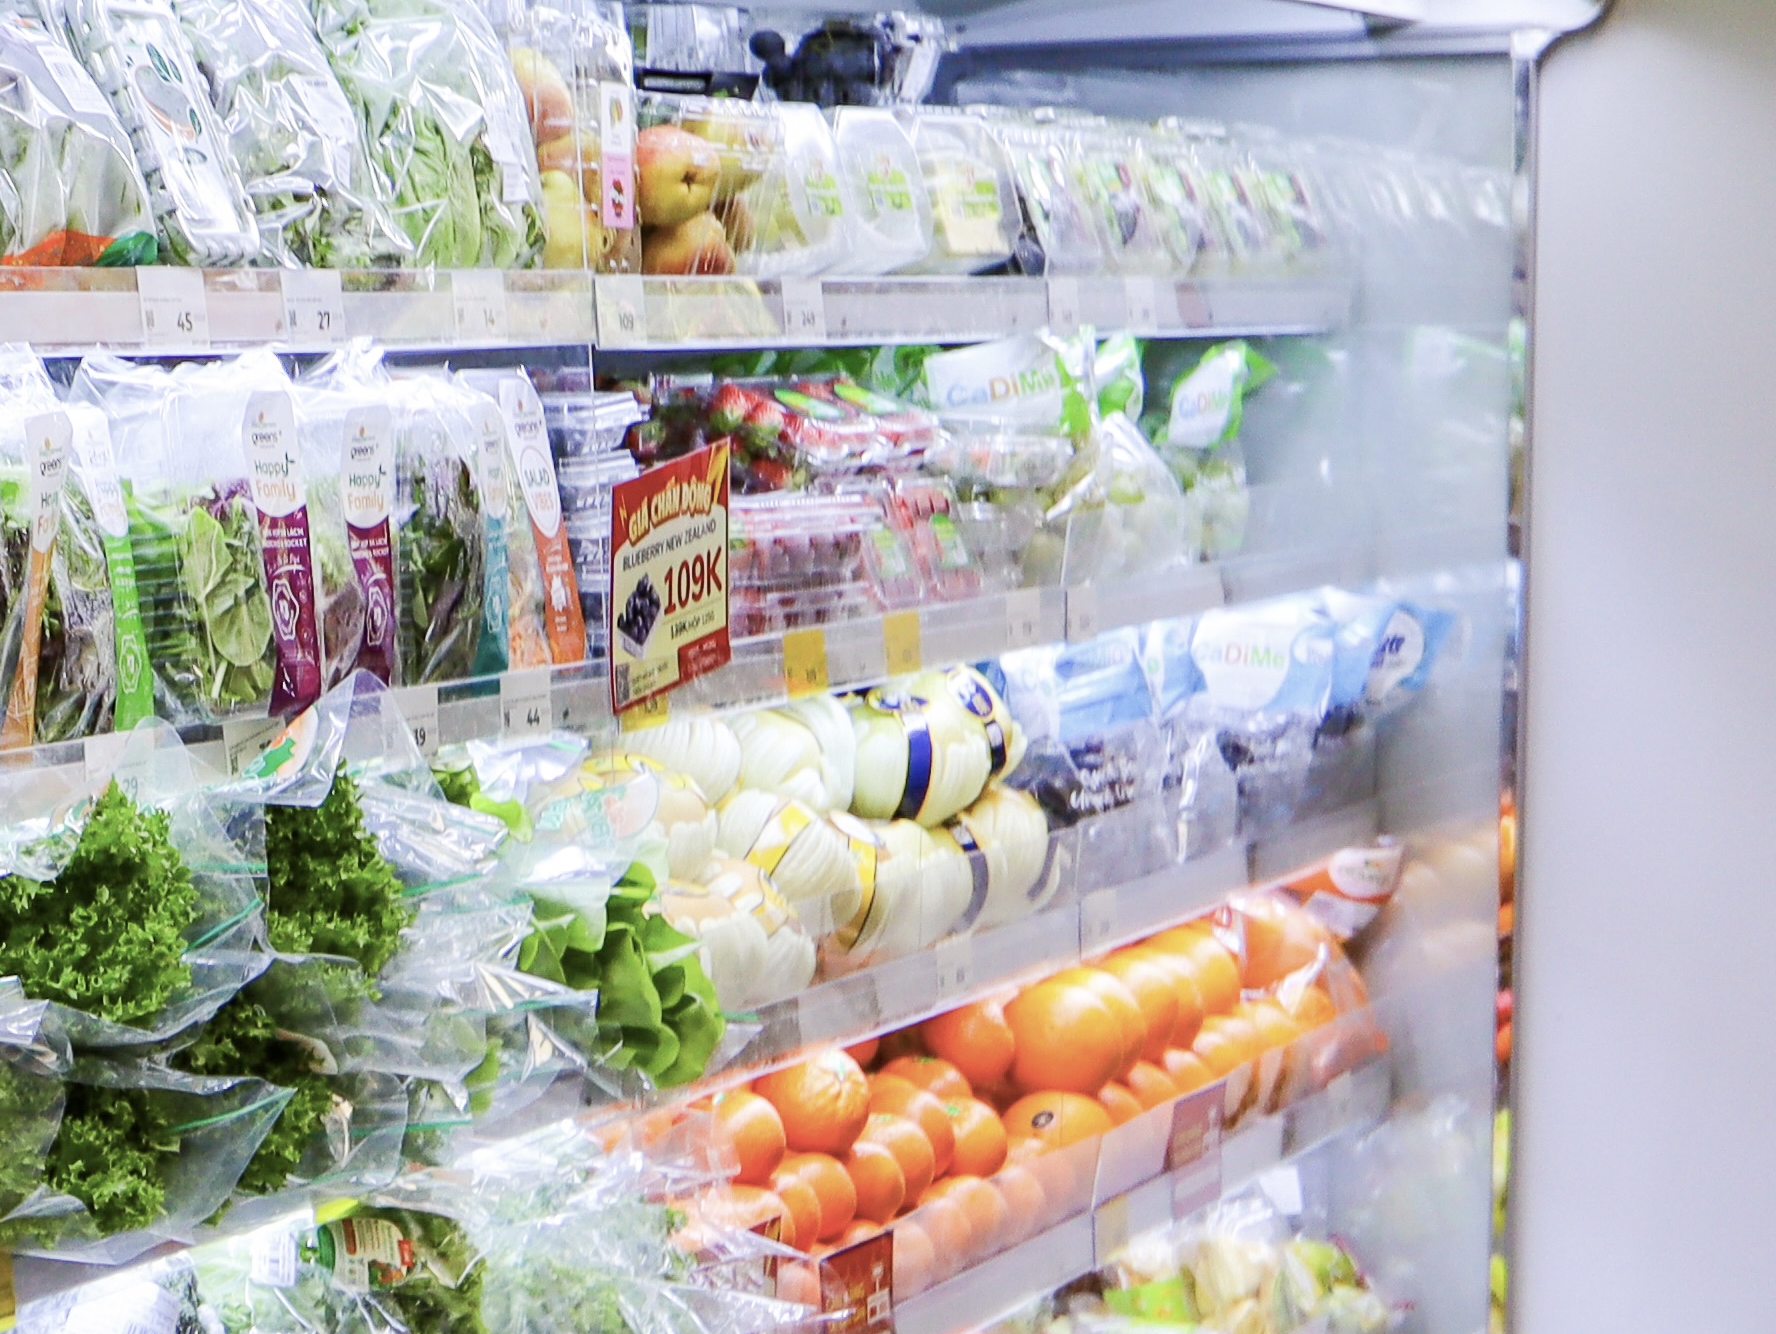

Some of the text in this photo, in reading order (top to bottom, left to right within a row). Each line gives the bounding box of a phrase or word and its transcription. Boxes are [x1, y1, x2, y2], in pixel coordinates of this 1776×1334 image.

[622, 518, 717, 572] BLUEBERRY NEW ZEALAND
[663, 546, 723, 616] 109K
